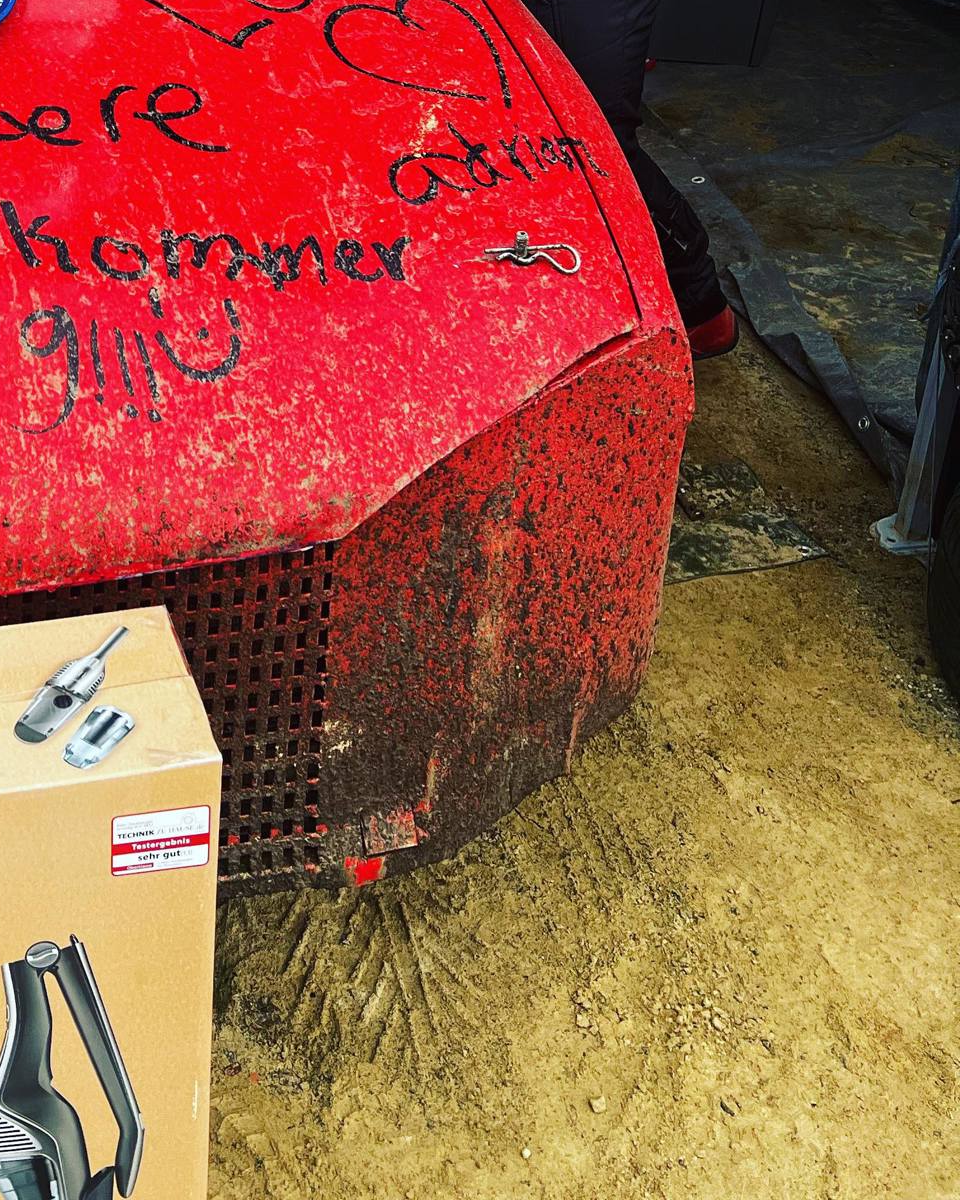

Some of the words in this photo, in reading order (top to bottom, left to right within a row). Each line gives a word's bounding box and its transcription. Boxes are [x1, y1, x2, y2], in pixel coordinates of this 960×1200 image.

[0, 200, 413, 291] kommer
[117, 830, 154, 839] TECHNIK
[132, 838, 190, 851] Testergebnis
[138, 852, 160, 861] sehr
[163, 850, 181, 860] gut
